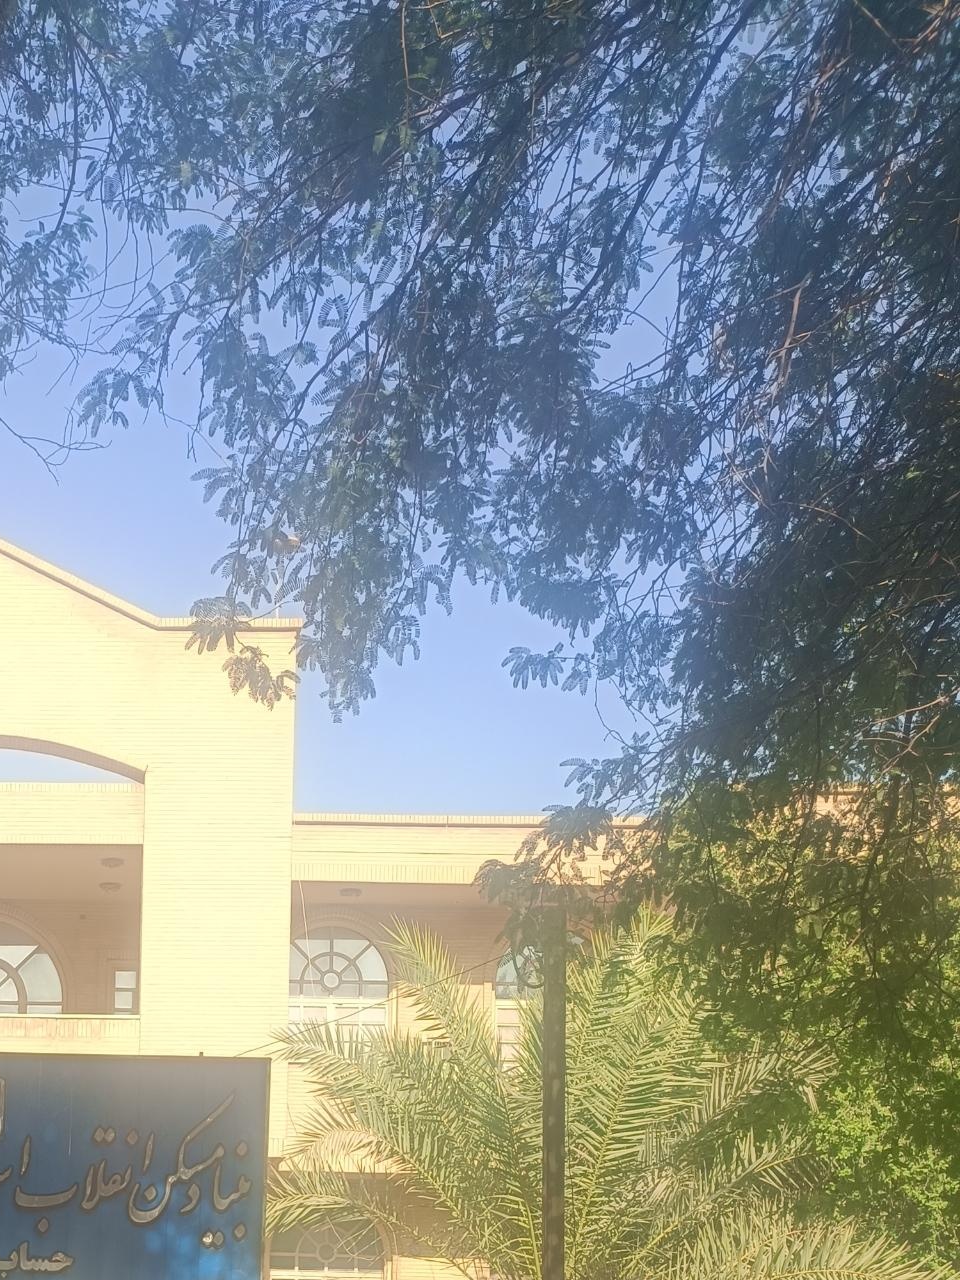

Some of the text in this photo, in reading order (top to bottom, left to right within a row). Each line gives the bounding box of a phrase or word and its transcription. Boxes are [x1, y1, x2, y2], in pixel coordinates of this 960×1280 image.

[14, 1126, 156, 1234] انقلاب
[128, 1093, 236, 1224] مسکن
[178, 1140, 253, 1248] بنیاد
